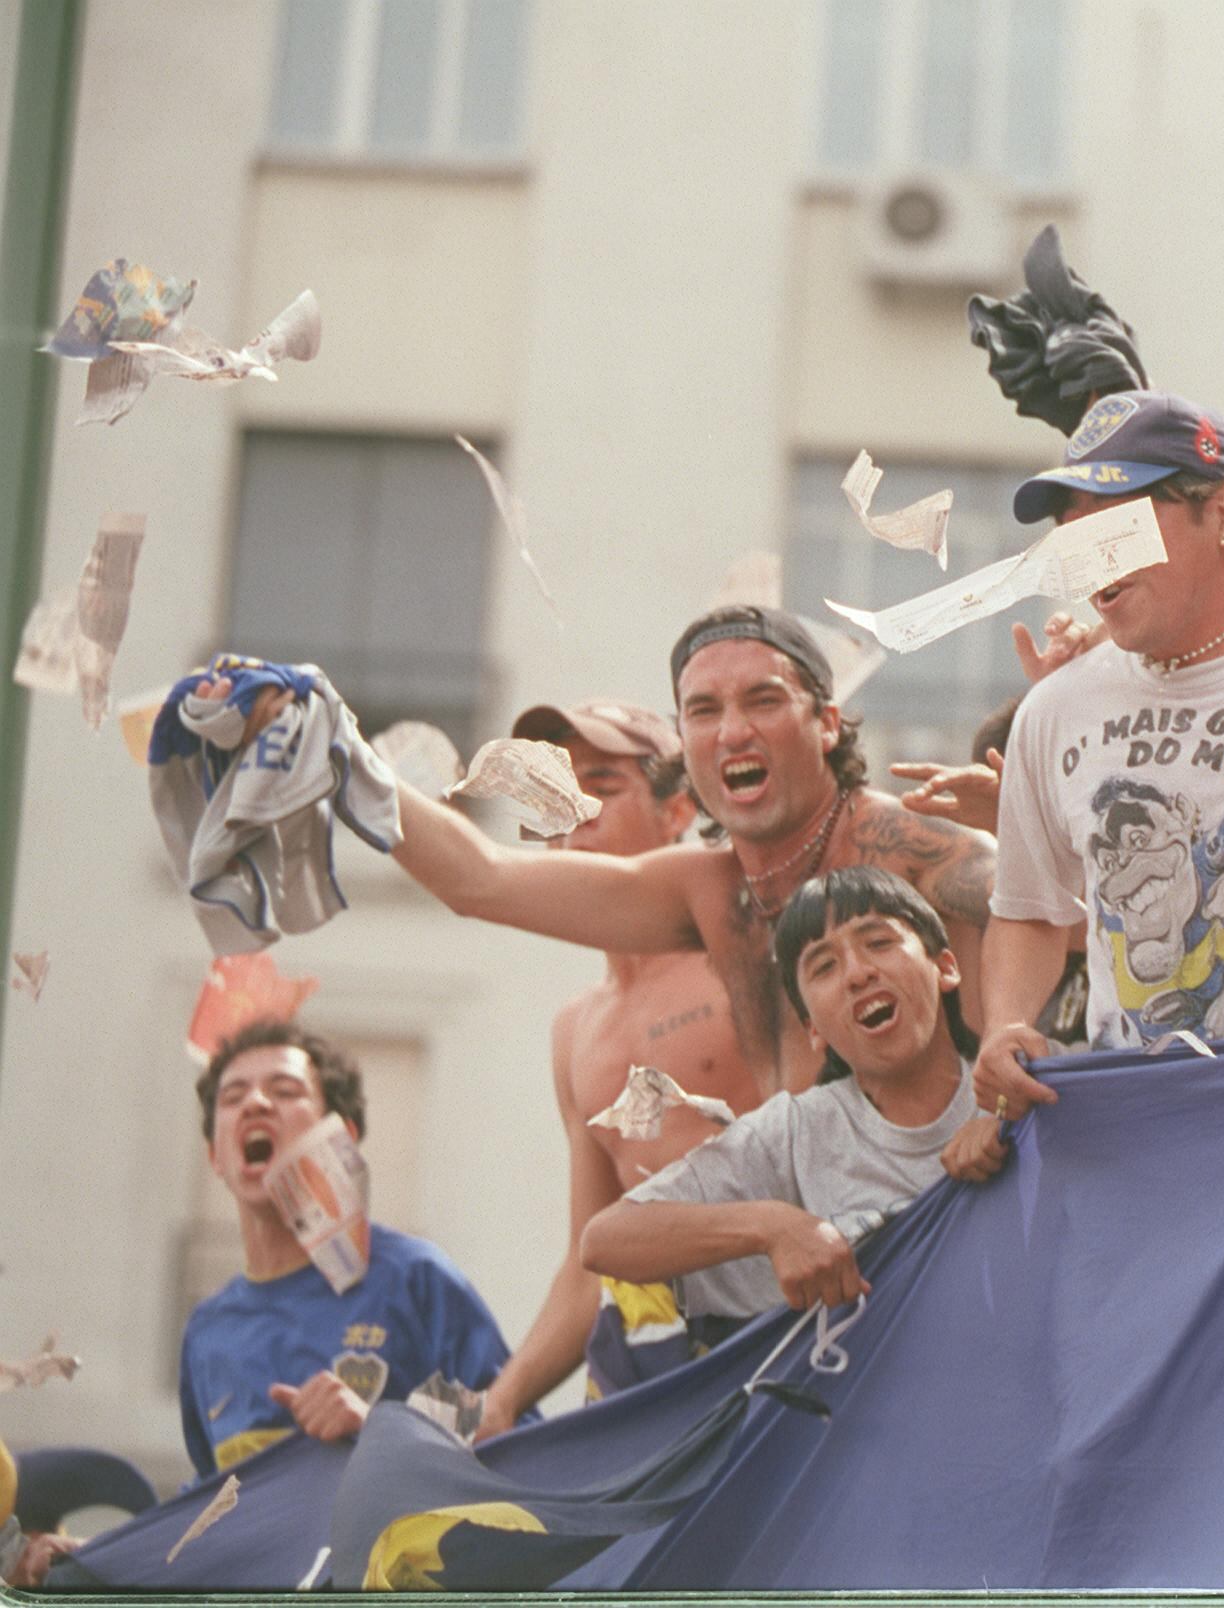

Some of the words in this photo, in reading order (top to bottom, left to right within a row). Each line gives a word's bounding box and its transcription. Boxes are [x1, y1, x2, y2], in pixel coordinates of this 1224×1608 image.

[1095, 464, 1129, 483] Jr.
[1102, 708, 1197, 745] MAIS
[1127, 737, 1181, 768] DO
